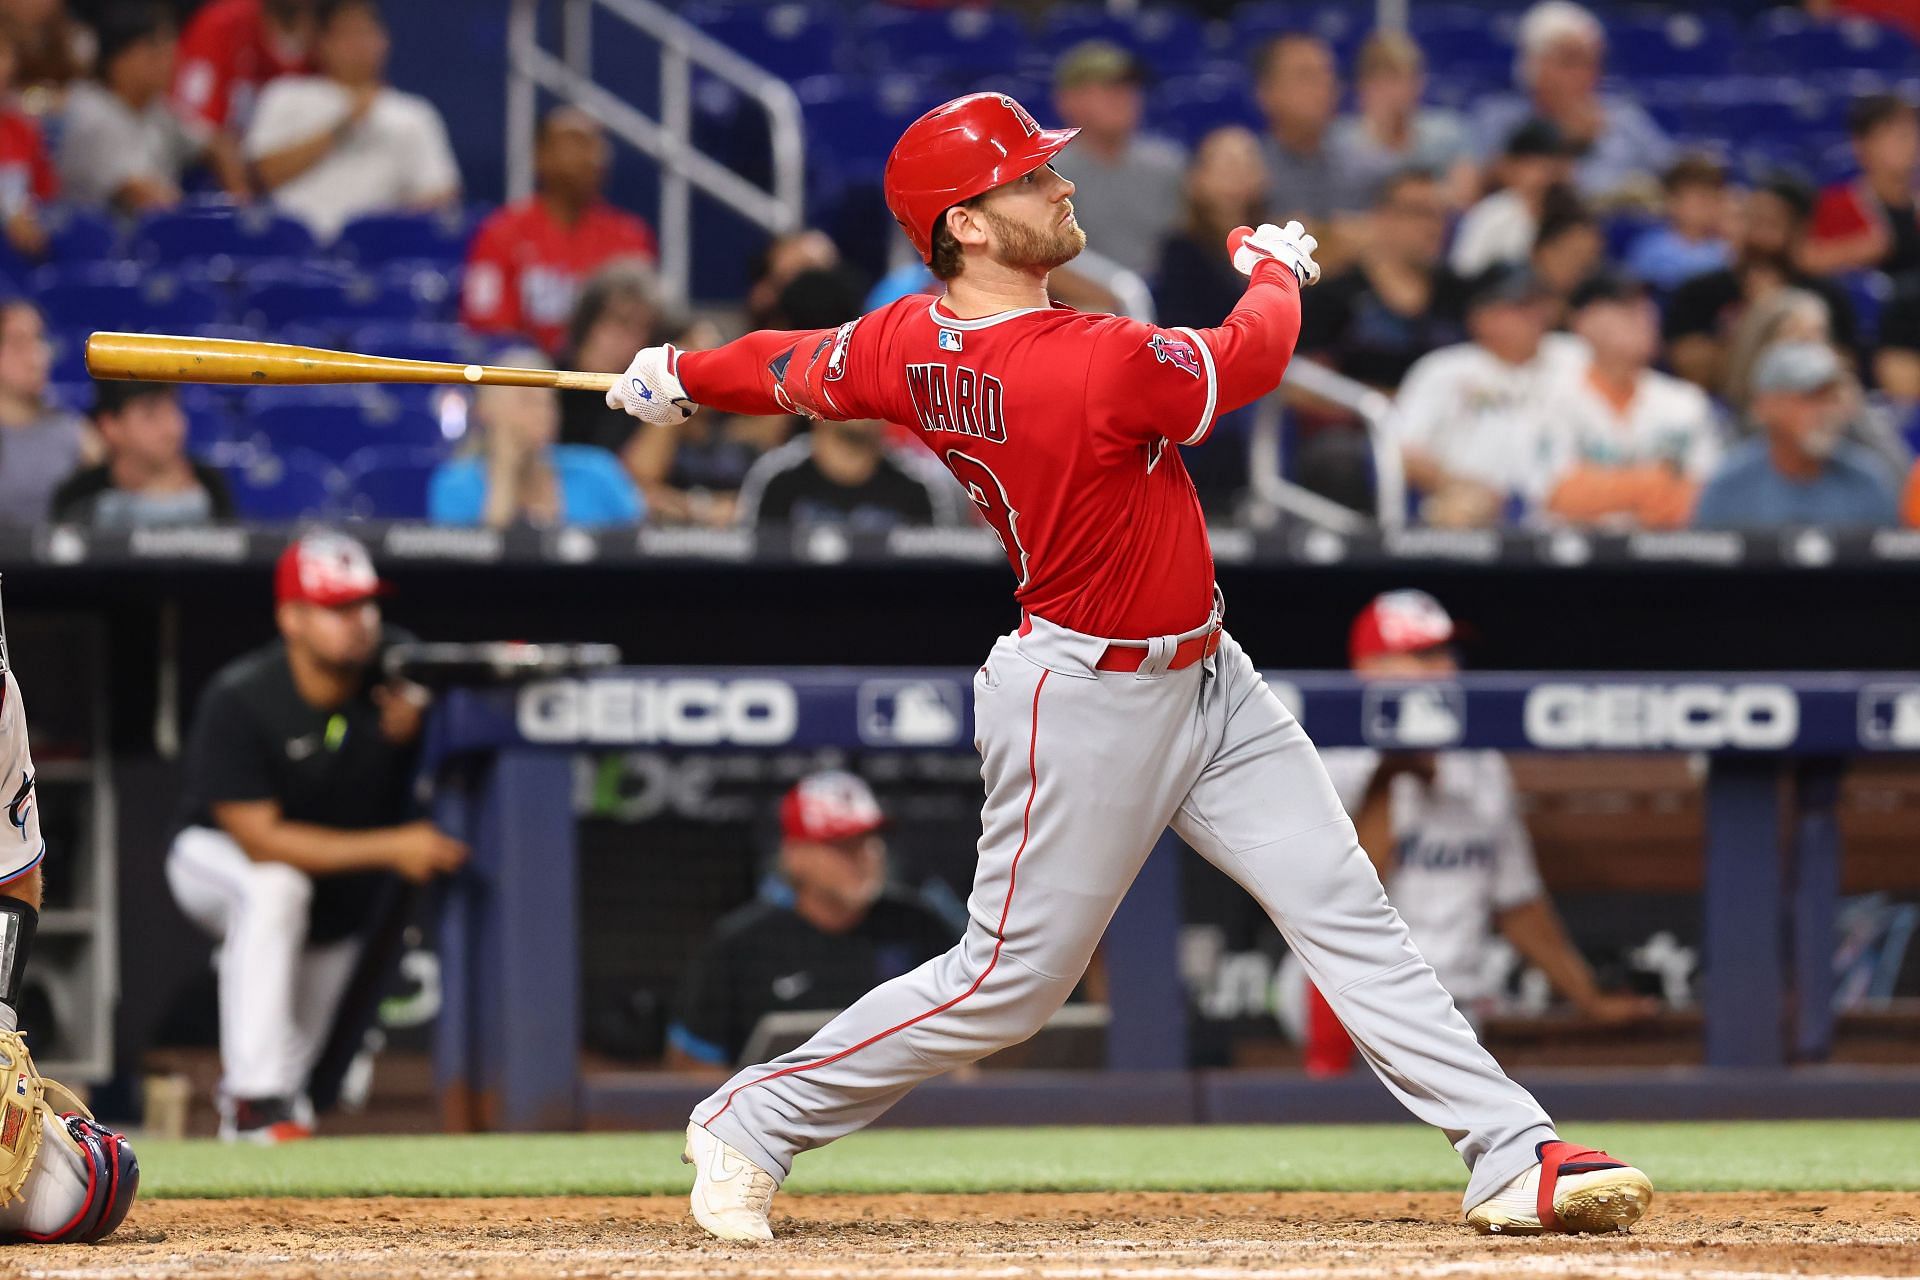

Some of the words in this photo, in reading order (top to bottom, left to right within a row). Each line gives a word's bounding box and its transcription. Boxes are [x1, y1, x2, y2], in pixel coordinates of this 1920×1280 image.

[1150, 334, 1200, 379] A
[906, 363, 1007, 443] WARD
[517, 679, 798, 744] GEICO
[1524, 684, 1799, 749] GEICO
